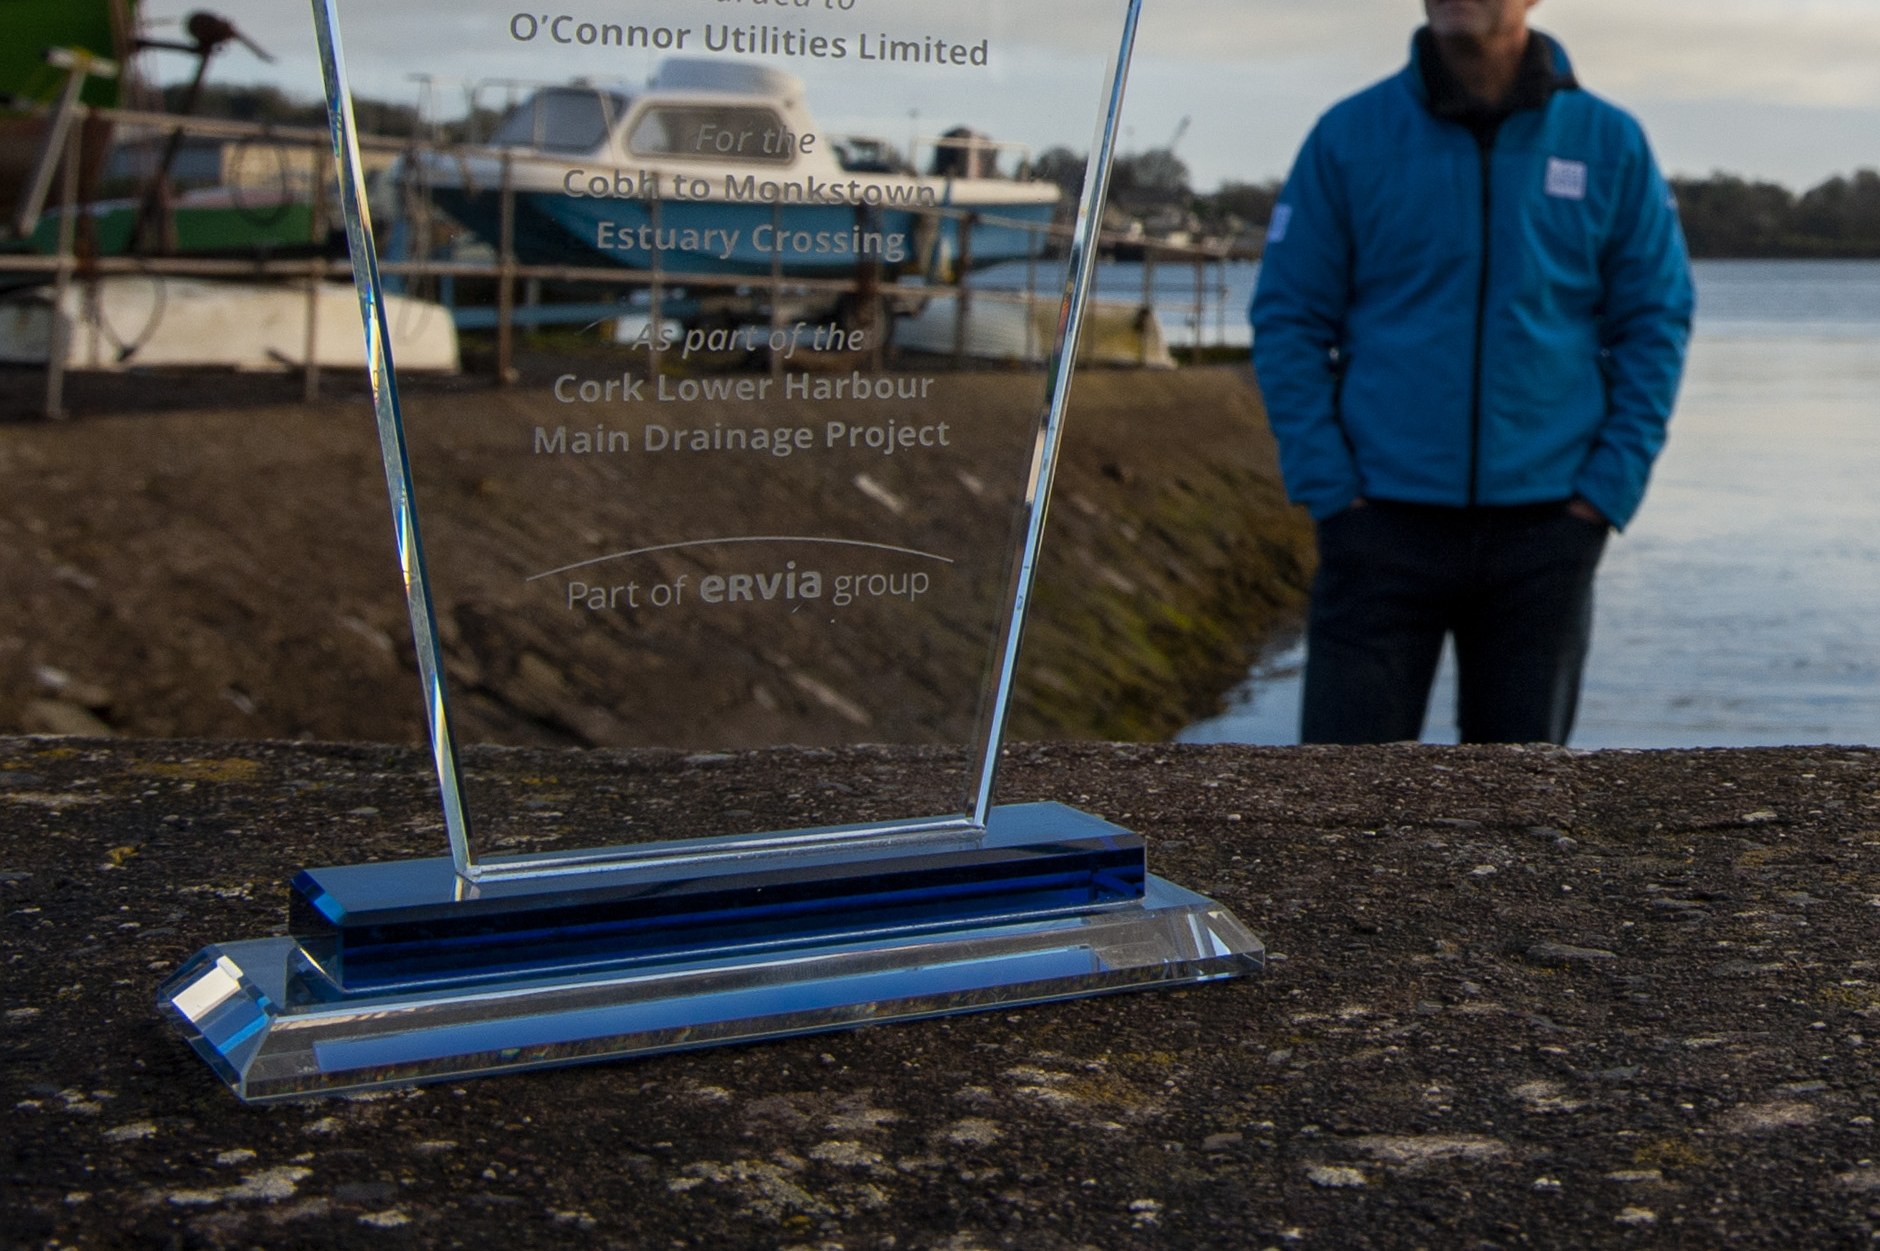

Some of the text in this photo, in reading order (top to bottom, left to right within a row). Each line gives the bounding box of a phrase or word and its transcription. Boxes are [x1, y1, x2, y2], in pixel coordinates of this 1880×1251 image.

[704, 24, 848, 60] Utilities
[859, 33, 989, 67] Limited
[696, 123, 816, 155] For the
[563, 169, 936, 208] Cobh to Monkstown
[597, 221, 906, 263] Estuary Crossing
[632, 322, 866, 359] As part of the
[554, 370, 934, 404] Cork Lower Harbour
[534, 419, 951, 457] Main Drainage Project
[568, 580, 640, 611] Part
[650, 574, 690, 606] of
[833, 570, 931, 606] group
